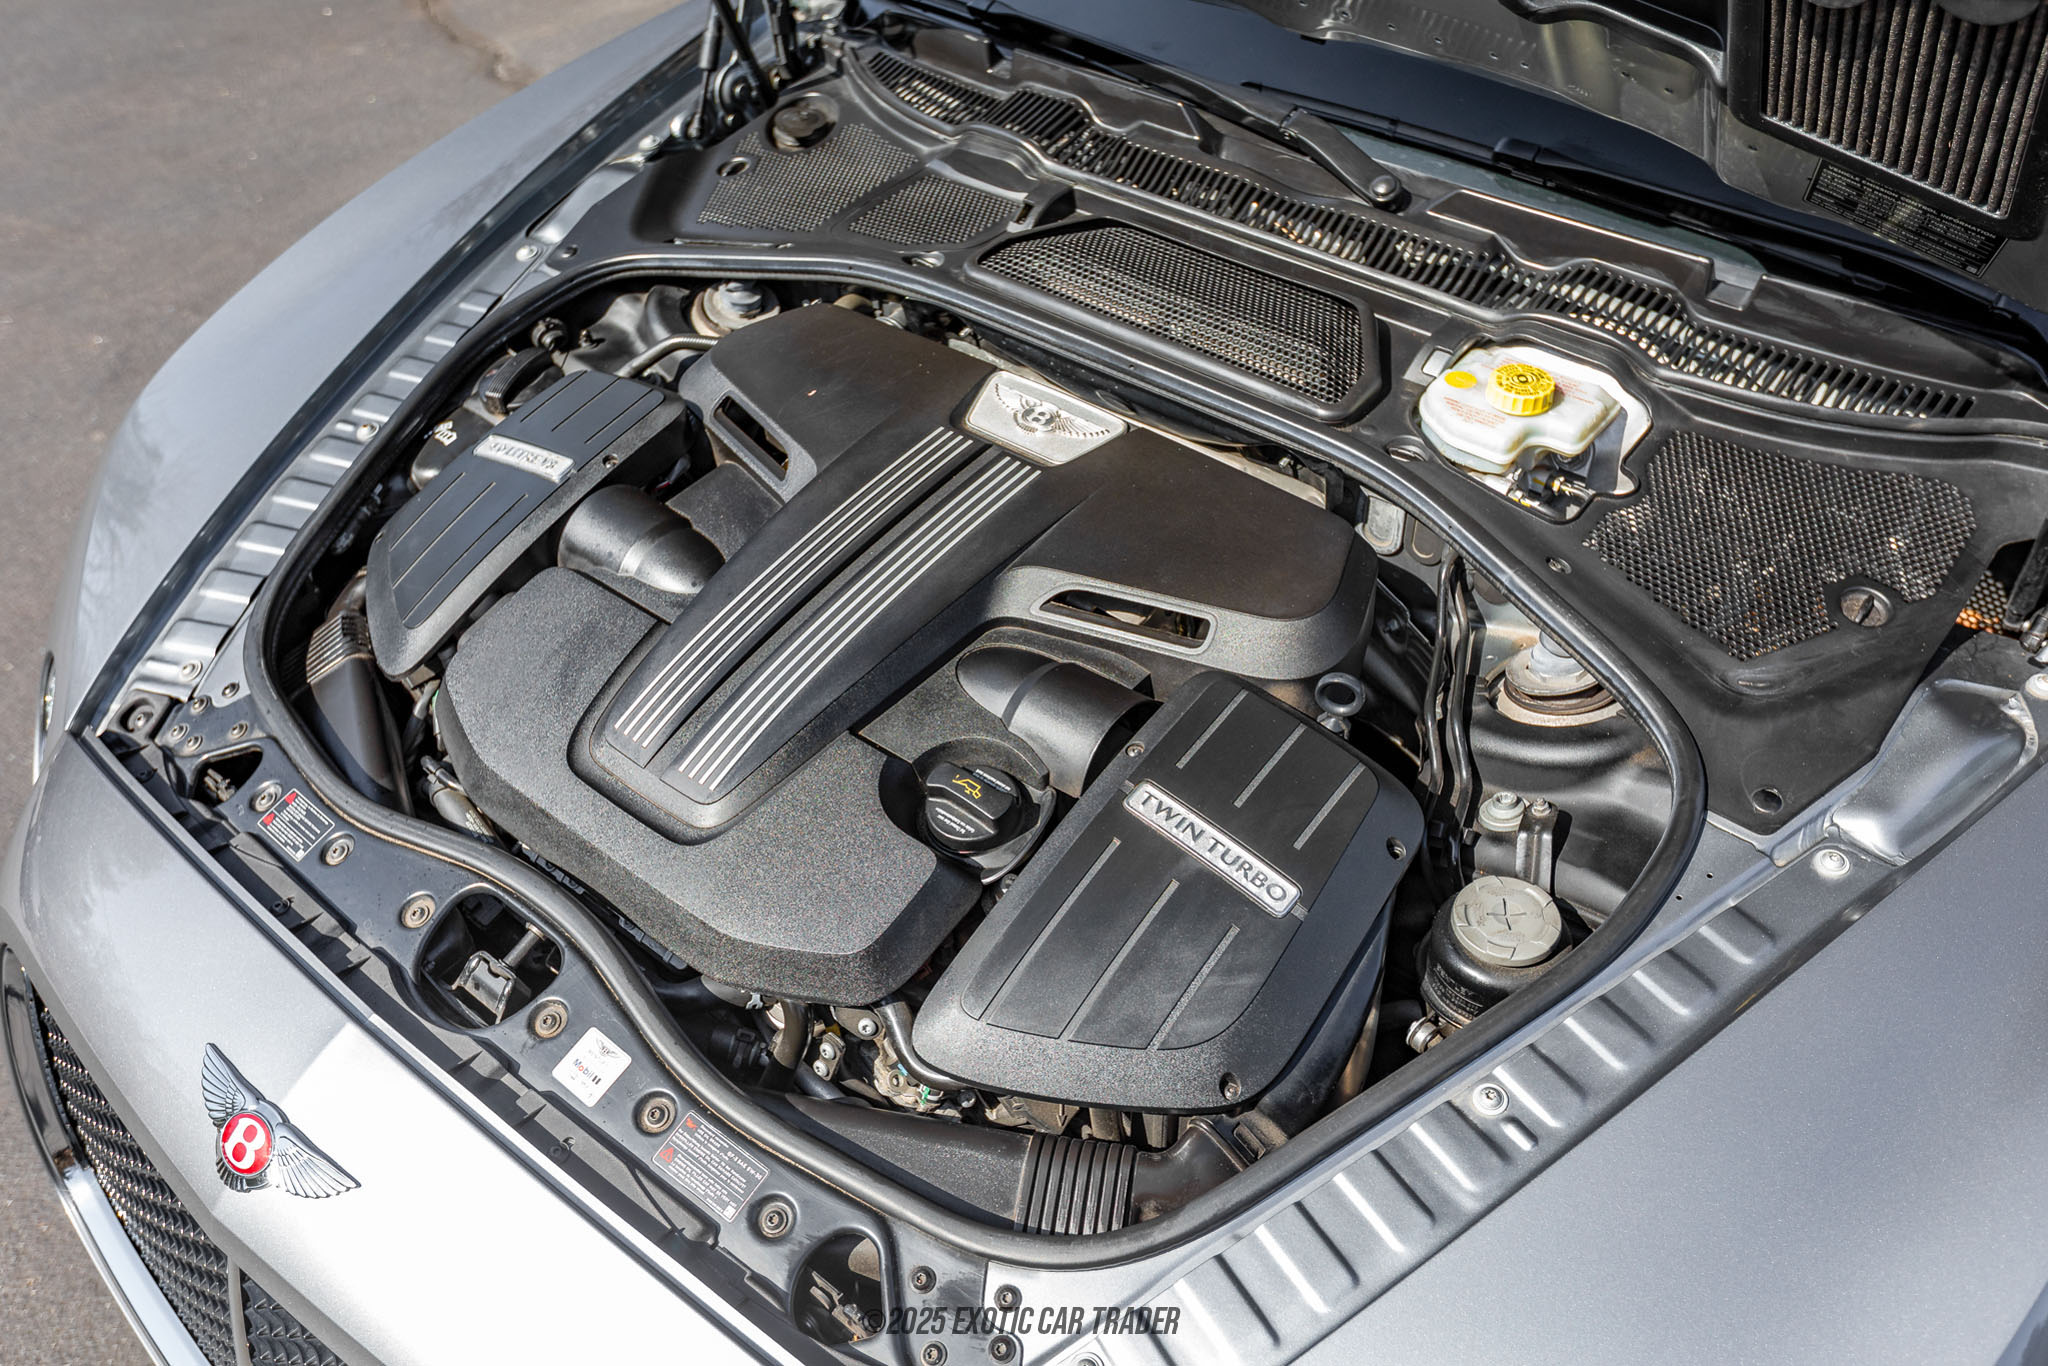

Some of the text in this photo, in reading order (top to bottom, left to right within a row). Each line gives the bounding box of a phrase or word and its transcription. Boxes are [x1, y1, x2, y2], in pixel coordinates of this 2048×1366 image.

[1828, 165, 1860, 181] VEHICLE
[1940, 212, 1996, 239] INFORMATION
[1141, 790, 1287, 901] TWIN TURBO
[573, 1058, 595, 1079] Mobil
[224, 1117, 266, 1170] B
